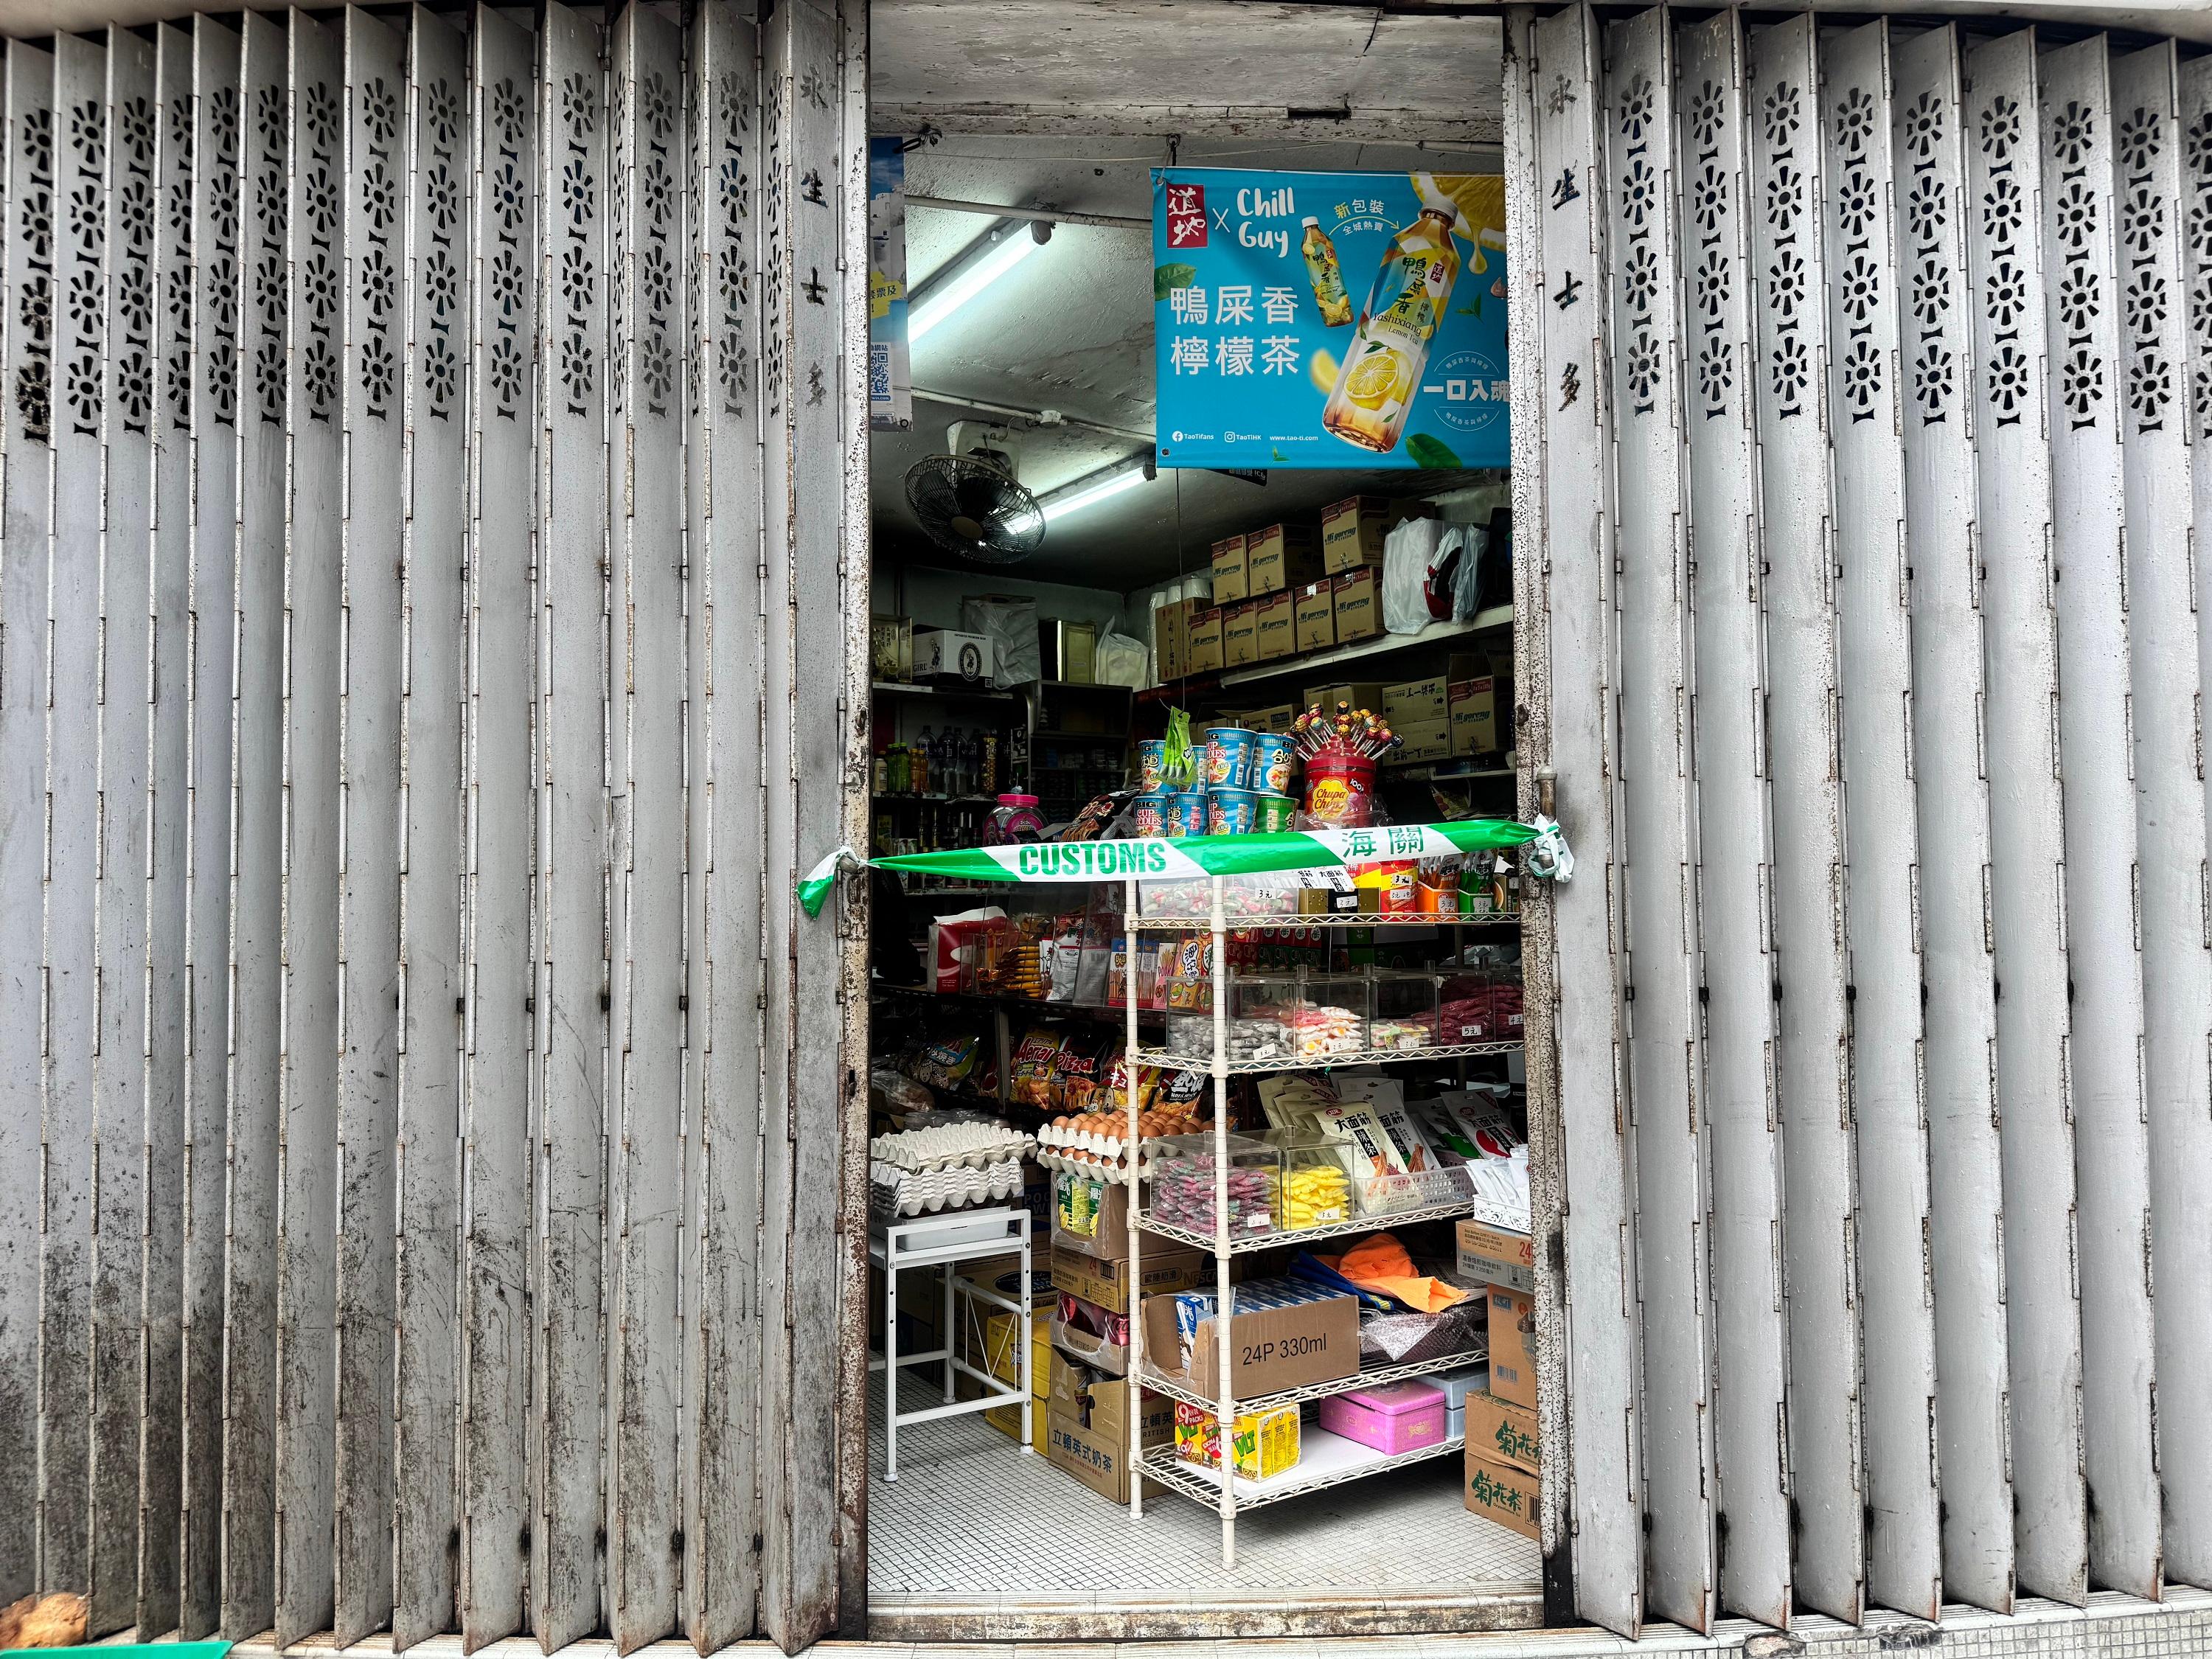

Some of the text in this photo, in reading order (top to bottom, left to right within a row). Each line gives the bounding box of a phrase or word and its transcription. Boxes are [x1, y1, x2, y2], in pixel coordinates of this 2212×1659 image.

[1237, 187, 1295, 218] Chill
[1334, 198, 1385, 219] 新包裝
[1343, 220, 1384, 236] 全城熱賣
[1238, 221, 1289, 258] Guy
[1169, 285, 1299, 326] 鴨屎香
[1373, 312, 1422, 337] Yashixiang
[1388, 325, 1408, 338] Lemon
[1169, 335, 1300, 376] 檸檬茶
[1347, 596, 1370, 609] goreng
[1307, 607, 1329, 620] goreng
[1316, 788, 1346, 801] Chupa
[1137, 809, 1155, 818] CUP
[1341, 826, 1425, 858] 海關
[1019, 844, 1166, 876] CUSTOMS
[1464, 1027, 1478, 1035] 5元
[1053, 1051, 1095, 1075] Pizza
[1335, 1111, 1371, 1133] 大面筋
[1377, 1110, 1405, 1128] 面筋
[1519, 1241, 1532, 1259] 24
[1242, 1332, 1327, 1366] 24P 330ml
[1178, 1404, 1190, 1425] 9
[1189, 1414, 1204, 1424] PACKS
[1142, 1427, 1170, 1439] RITISH
[1052, 1428, 1113, 1474] 立頓英式奶茶
[1234, 1430, 1256, 1458] VLT
[1471, 1469, 1523, 1512] 菊花茶
